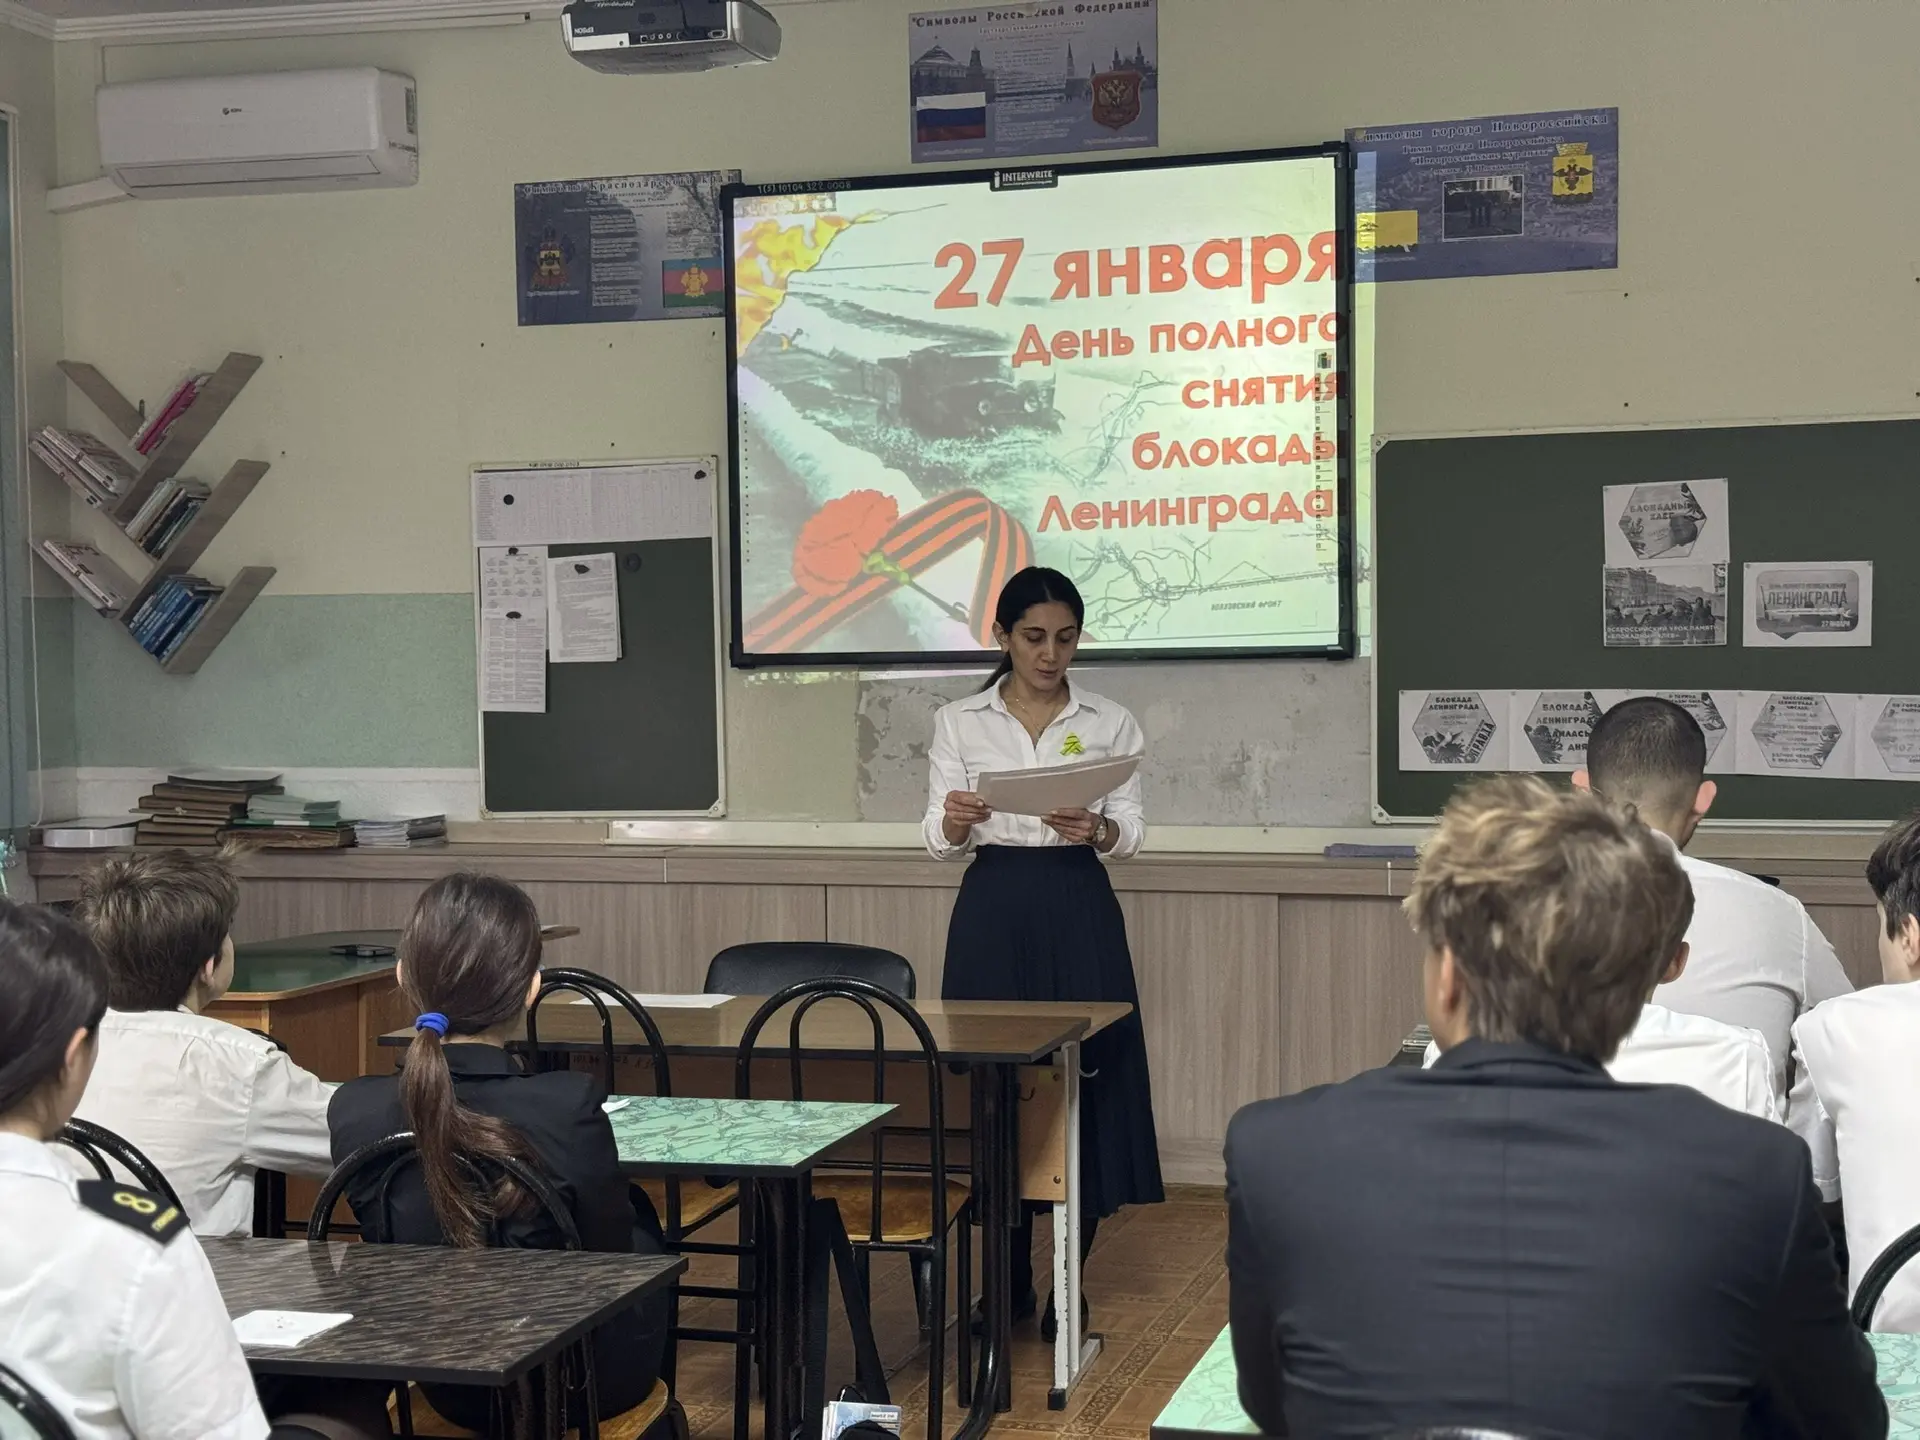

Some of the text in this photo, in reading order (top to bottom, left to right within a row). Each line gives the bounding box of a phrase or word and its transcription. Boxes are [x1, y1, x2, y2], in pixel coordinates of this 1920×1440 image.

[1491, 113, 1608, 133] Новороссийска
[1002, 170, 1053, 183] INTERWRITE
[934, 230, 1340, 309] 27 января
[1012, 312, 1344, 368] День полного
[1182, 373, 1345, 409] снятия
[1768, 590, 1849, 606] ЛЕНИНГРАДА
[1428, 703, 1480, 711] ЛЕНИНГРАДА
[1542, 703, 1589, 712] БЛОКАДА
